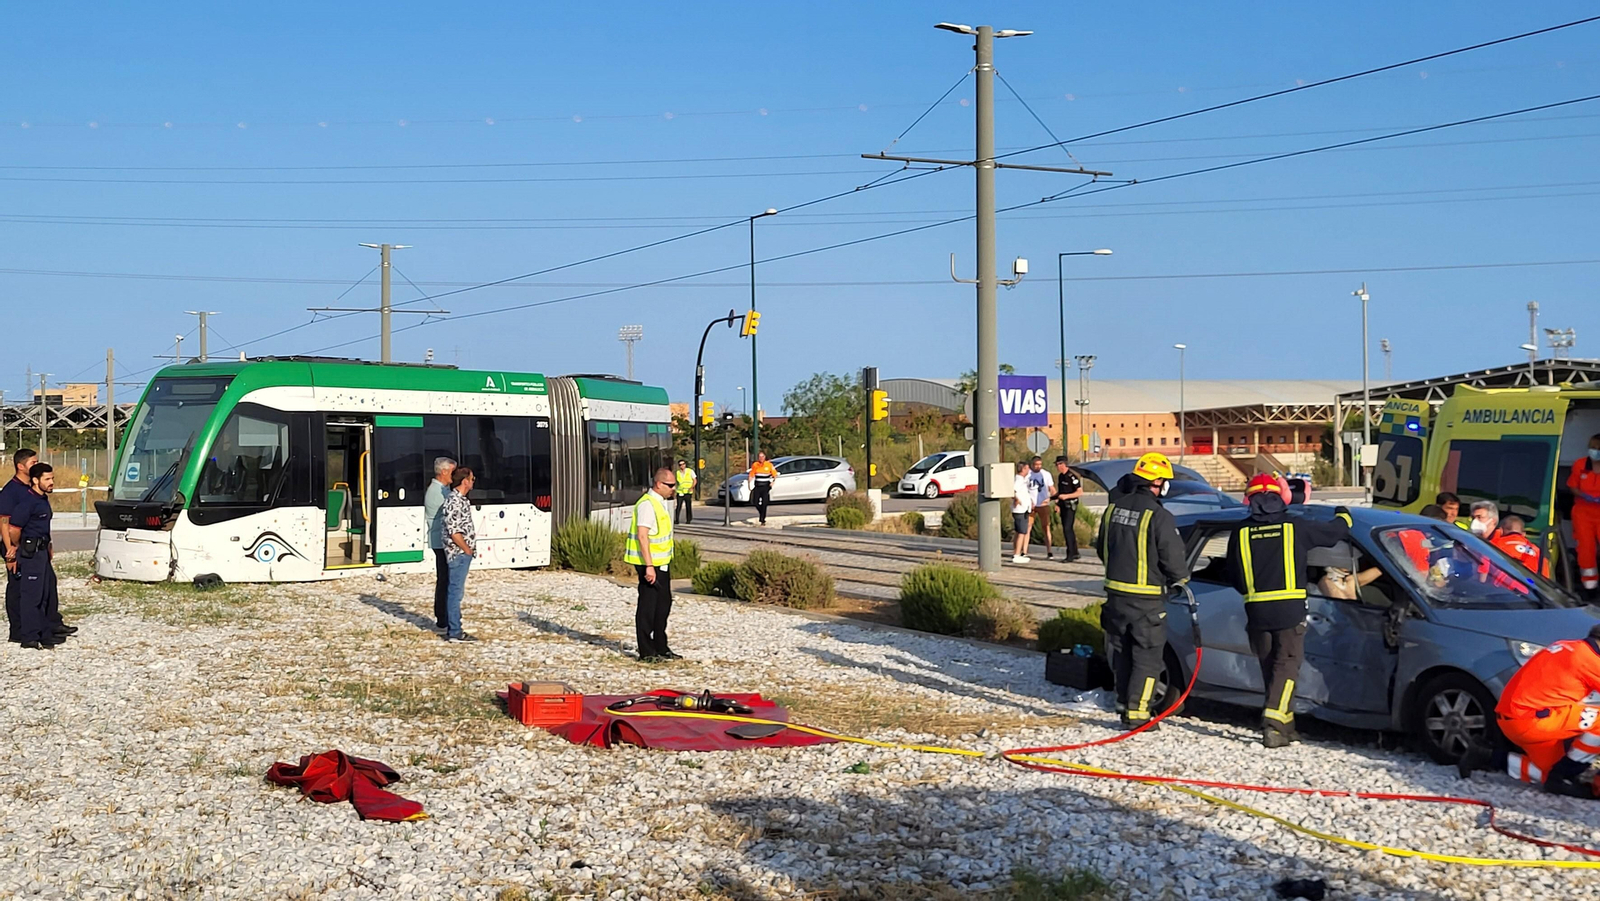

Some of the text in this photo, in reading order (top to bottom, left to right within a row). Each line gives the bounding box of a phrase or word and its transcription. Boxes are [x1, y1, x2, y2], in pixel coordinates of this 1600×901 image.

[1000, 388, 1046, 414] VIAS
[1461, 409, 1555, 424] AMBULANCIA
[1373, 440, 1412, 502] 61
